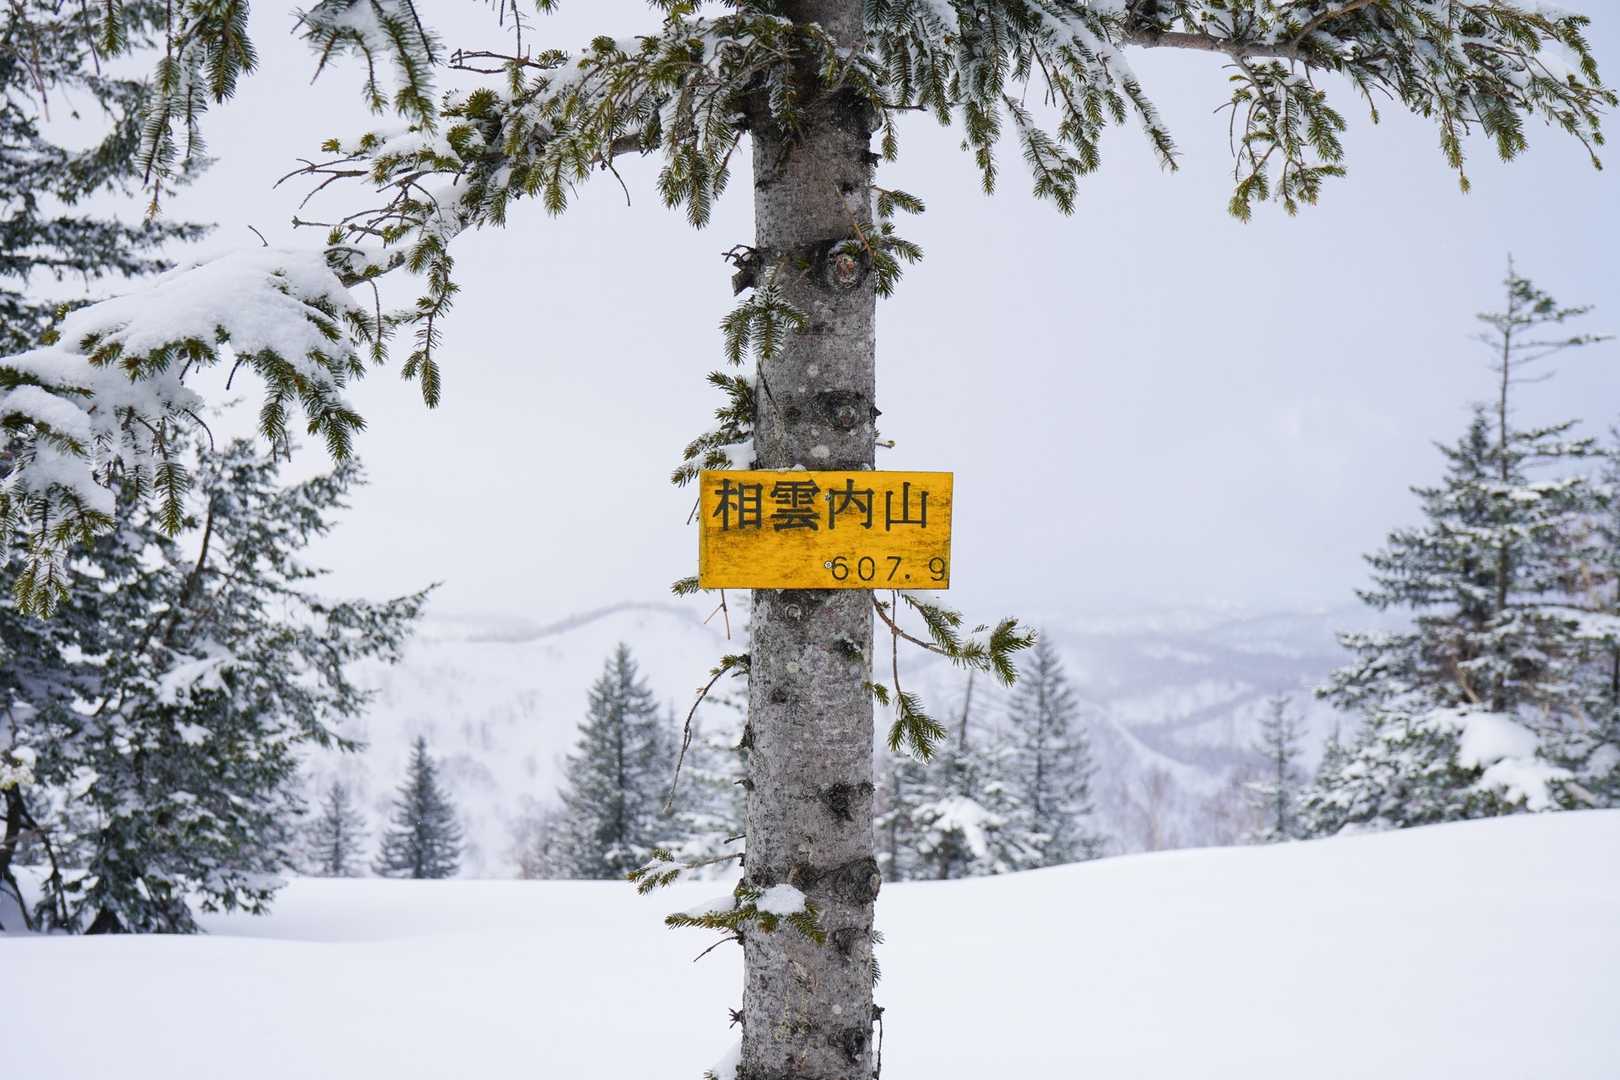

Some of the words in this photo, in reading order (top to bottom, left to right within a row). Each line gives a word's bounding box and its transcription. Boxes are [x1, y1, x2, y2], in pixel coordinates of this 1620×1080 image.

[712, 478, 929, 532] 相雲内山
[831, 556, 946, 581] 607.9
